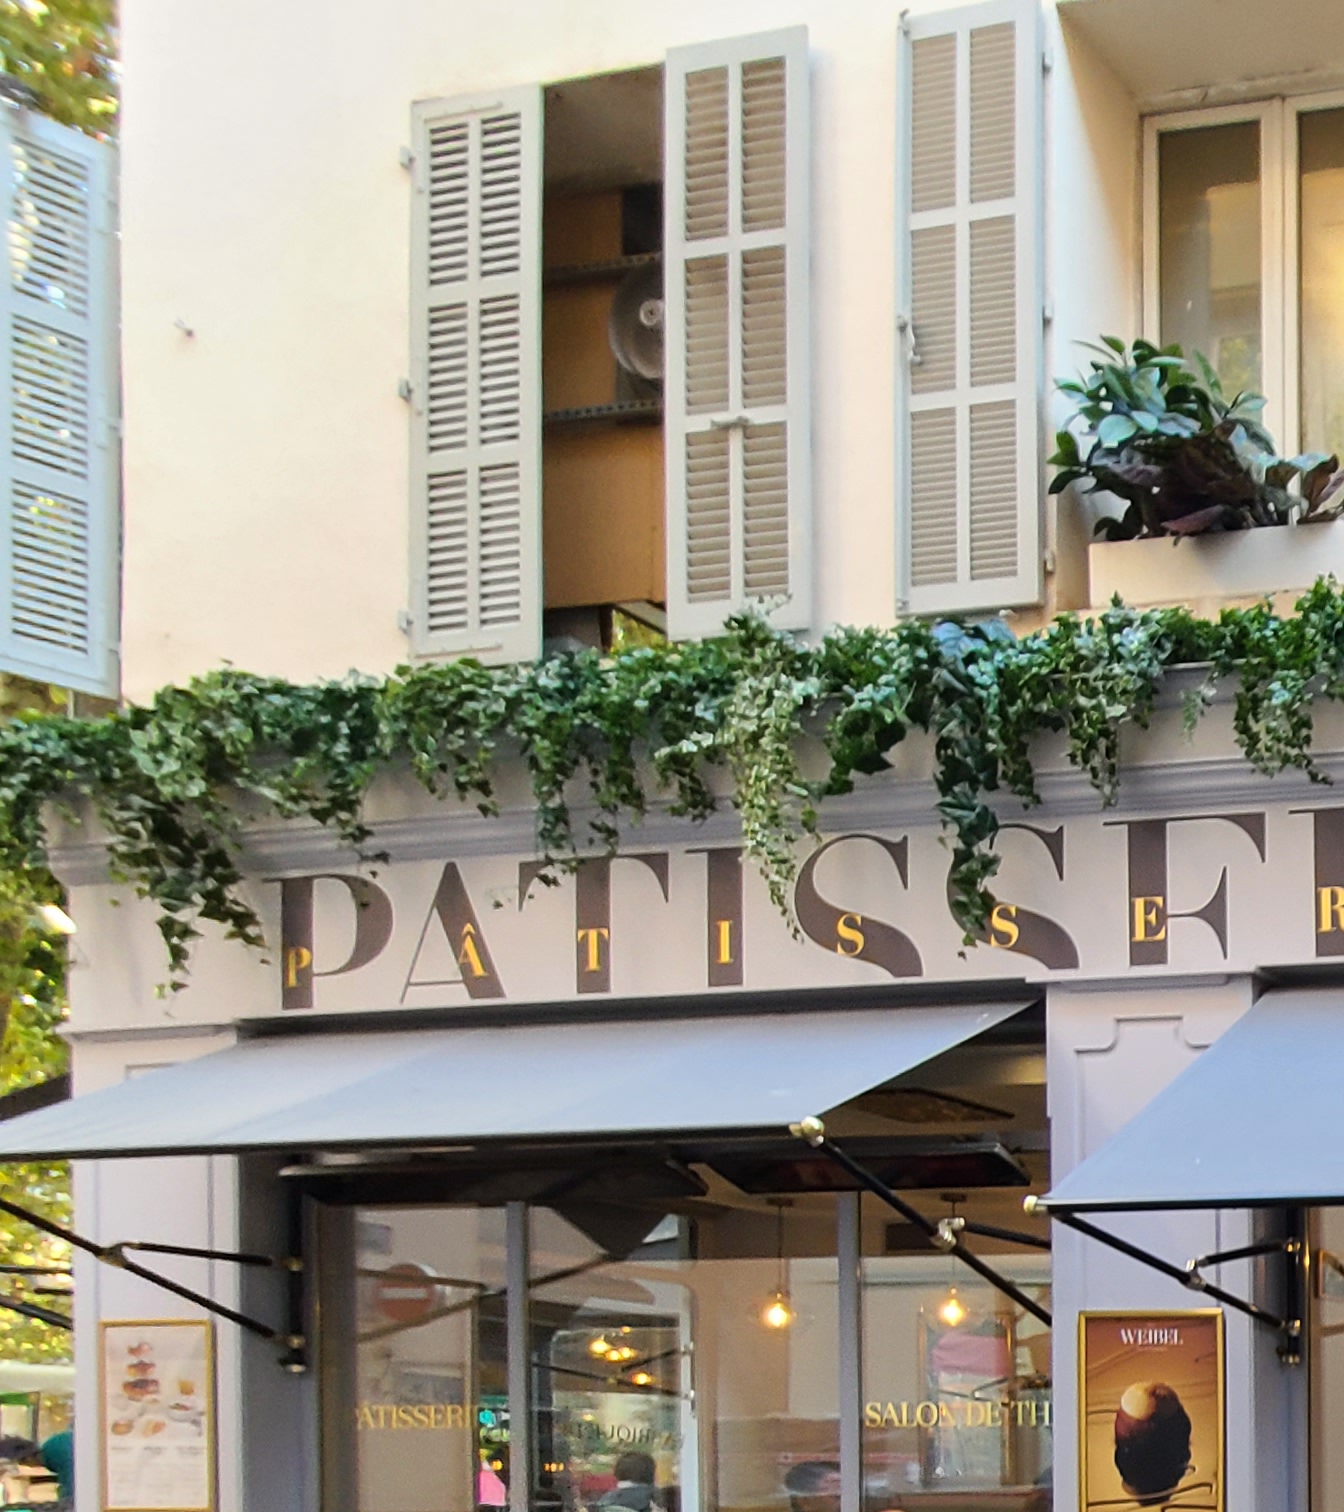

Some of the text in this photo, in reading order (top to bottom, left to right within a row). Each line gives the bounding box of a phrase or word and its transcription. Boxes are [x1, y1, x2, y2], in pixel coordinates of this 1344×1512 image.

[1120, 1328, 1184, 1346] WEIBEL
[864, 1400, 1052, 1429] SALON DE TH
